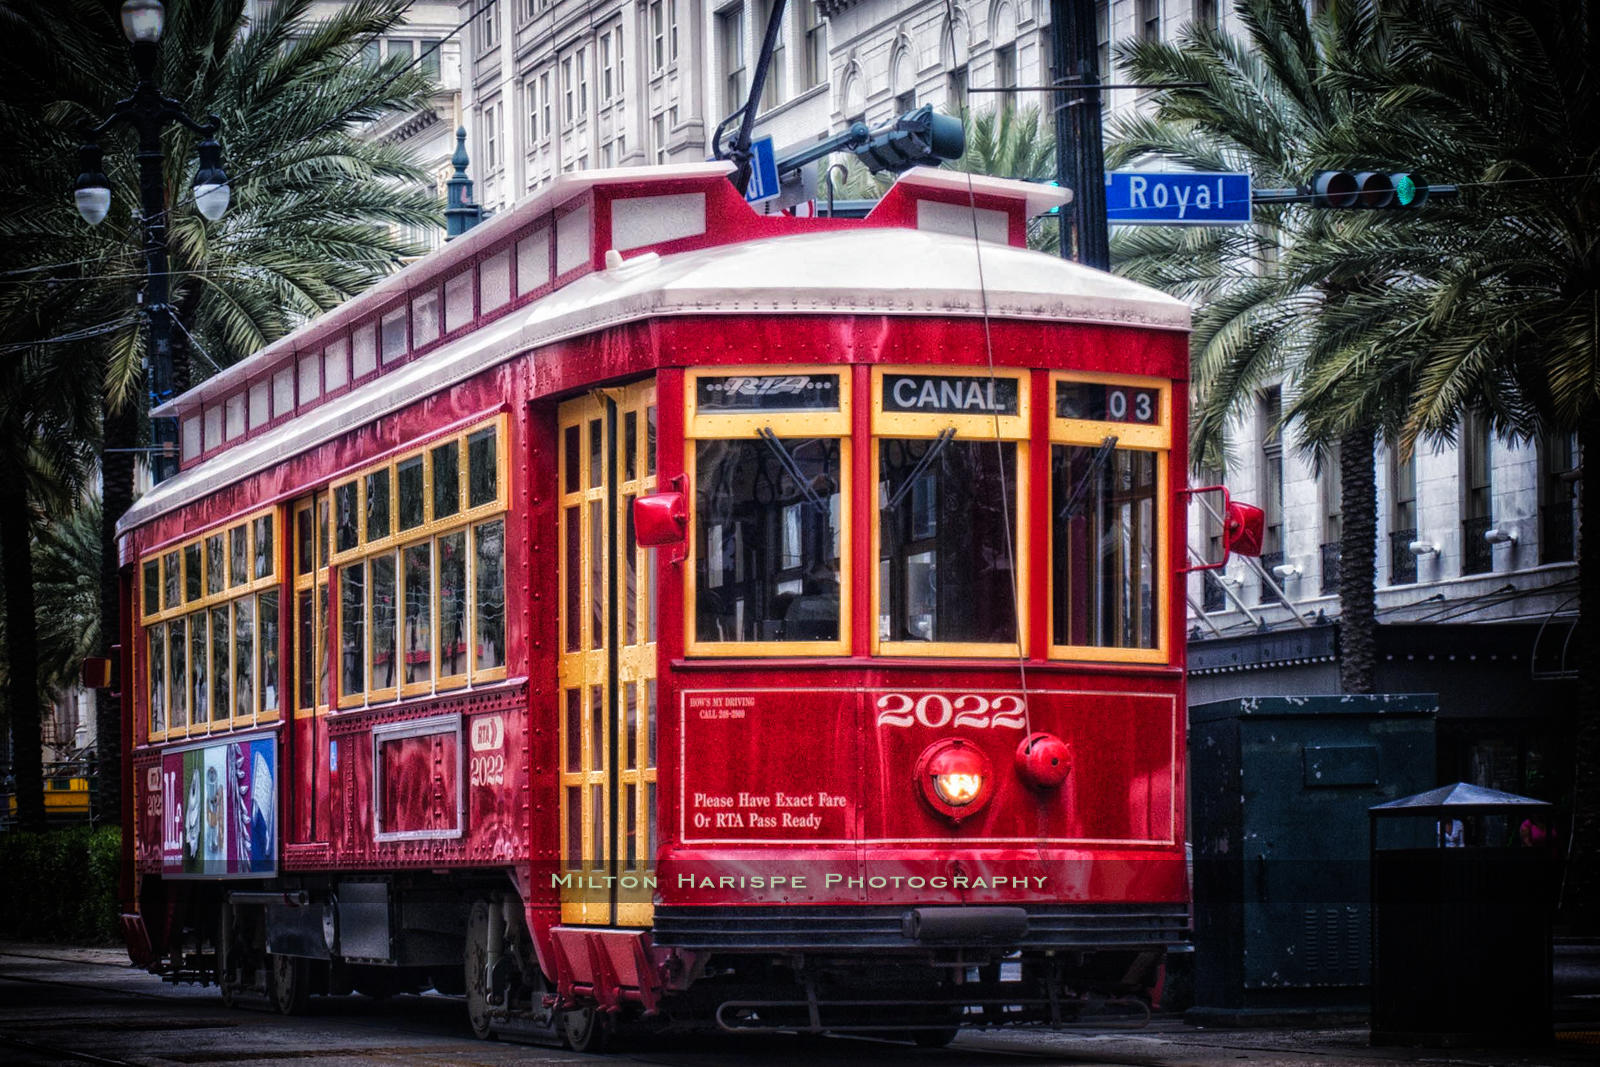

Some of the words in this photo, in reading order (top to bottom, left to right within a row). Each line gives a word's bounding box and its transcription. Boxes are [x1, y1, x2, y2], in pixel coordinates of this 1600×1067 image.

[1130, 176, 1224, 219] Royal
[893, 379, 1006, 411] CANAL
[689, 697, 711, 707] HOW'S
[712, 697, 723, 707] MY
[725, 696, 755, 707] DRIVING
[877, 693, 1026, 730] 2022
[699, 709, 718, 719] CALL
[471, 754, 504, 787] 2022
[694, 792, 734, 808] Please
[738, 792, 771, 808] Have
[776, 792, 813, 808] Exact
[818, 792, 847, 808] Fare
[694, 813, 711, 828] Or
[716, 813, 745, 828] RTA
[750, 813, 777, 828] Pass
[782, 813, 822, 830] Ready
